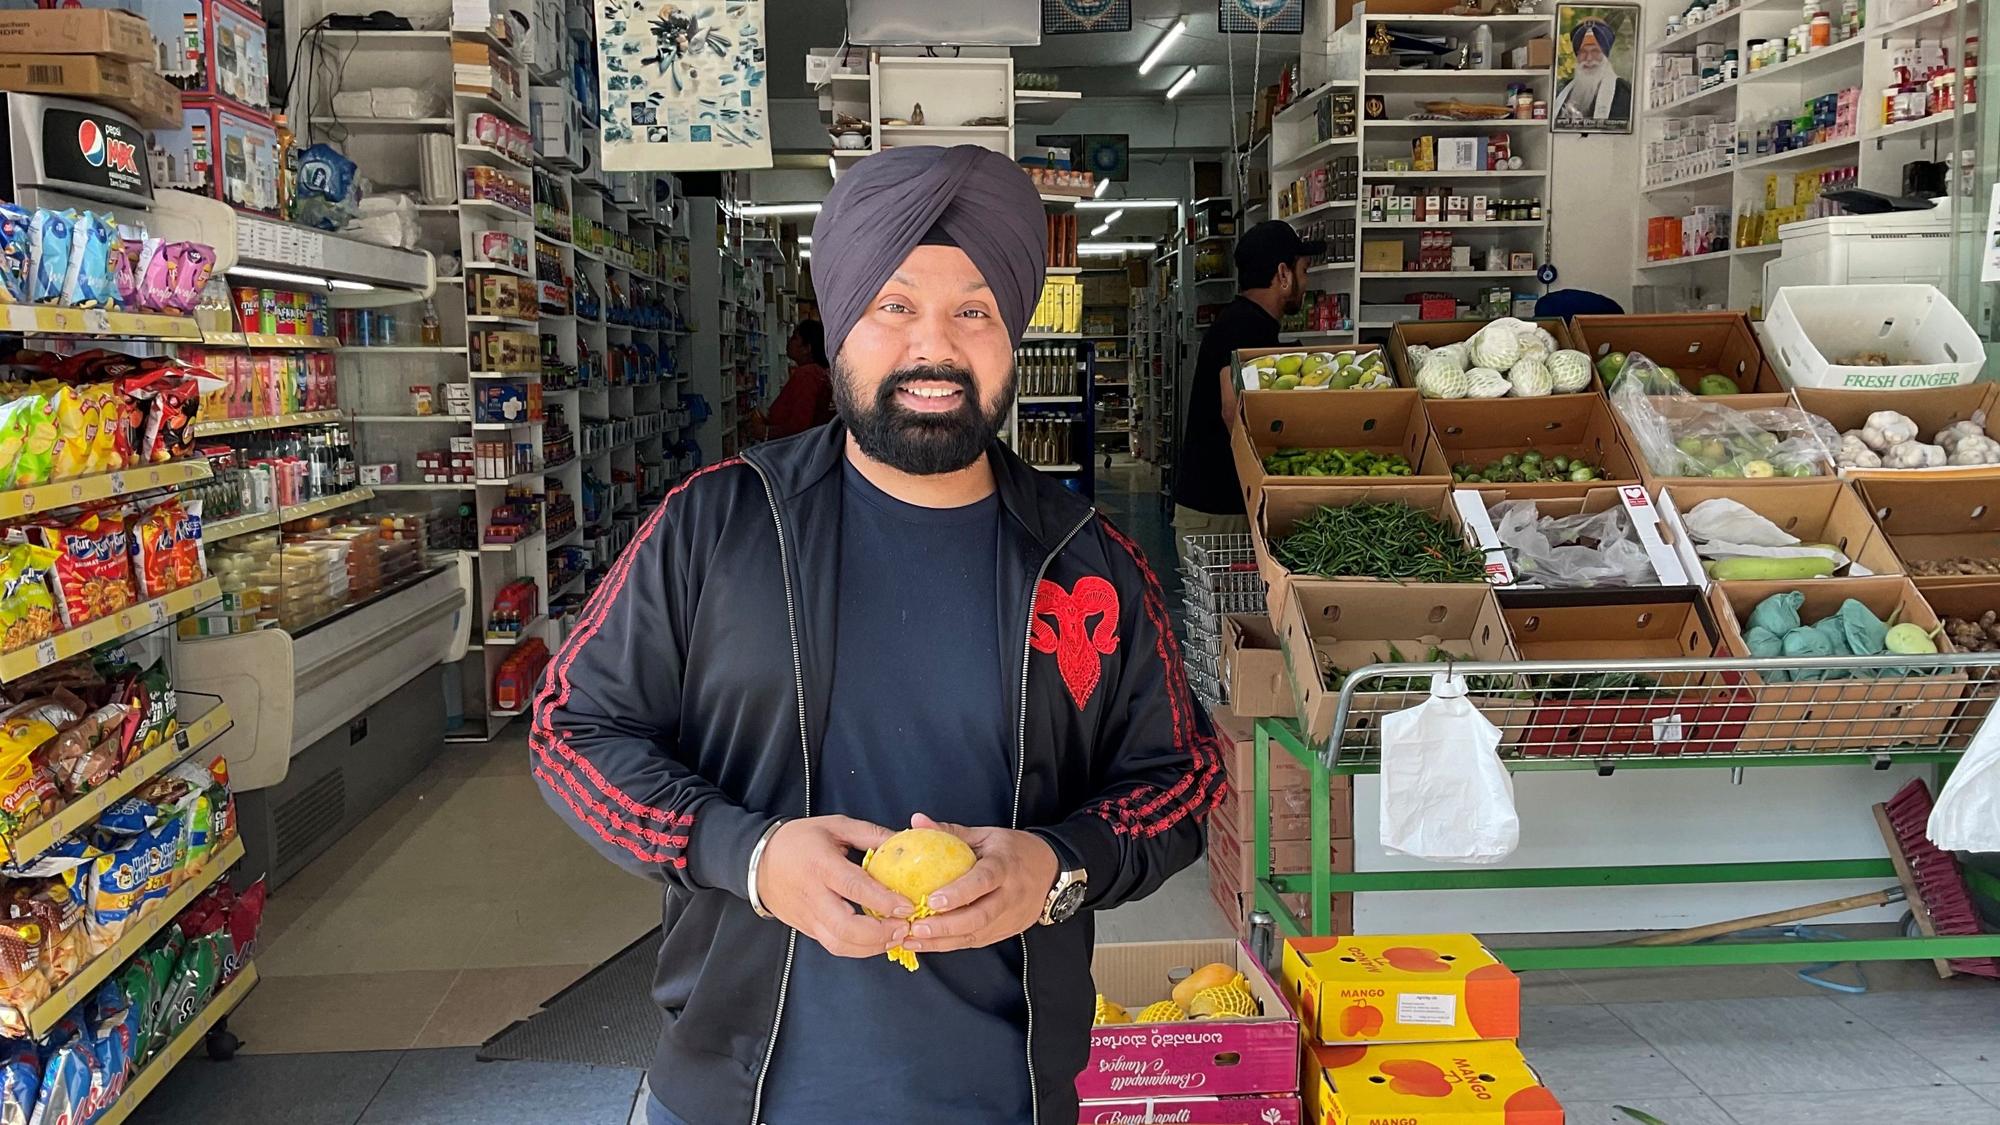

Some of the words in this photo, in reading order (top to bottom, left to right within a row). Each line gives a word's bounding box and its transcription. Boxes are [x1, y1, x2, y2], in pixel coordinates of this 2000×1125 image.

[105, 124, 121, 137] pepsi
[106, 137, 140, 176] MAX
[1843, 374, 1897, 388] FRESH
[1900, 371, 1960, 387] GINGER
[1340, 988, 1385, 999] MANGO
[1099, 1055, 1164, 1075] Mangoes
[1109, 1069, 1206, 1091] Banganapalli
[1452, 1057, 1492, 1102] MANGO
